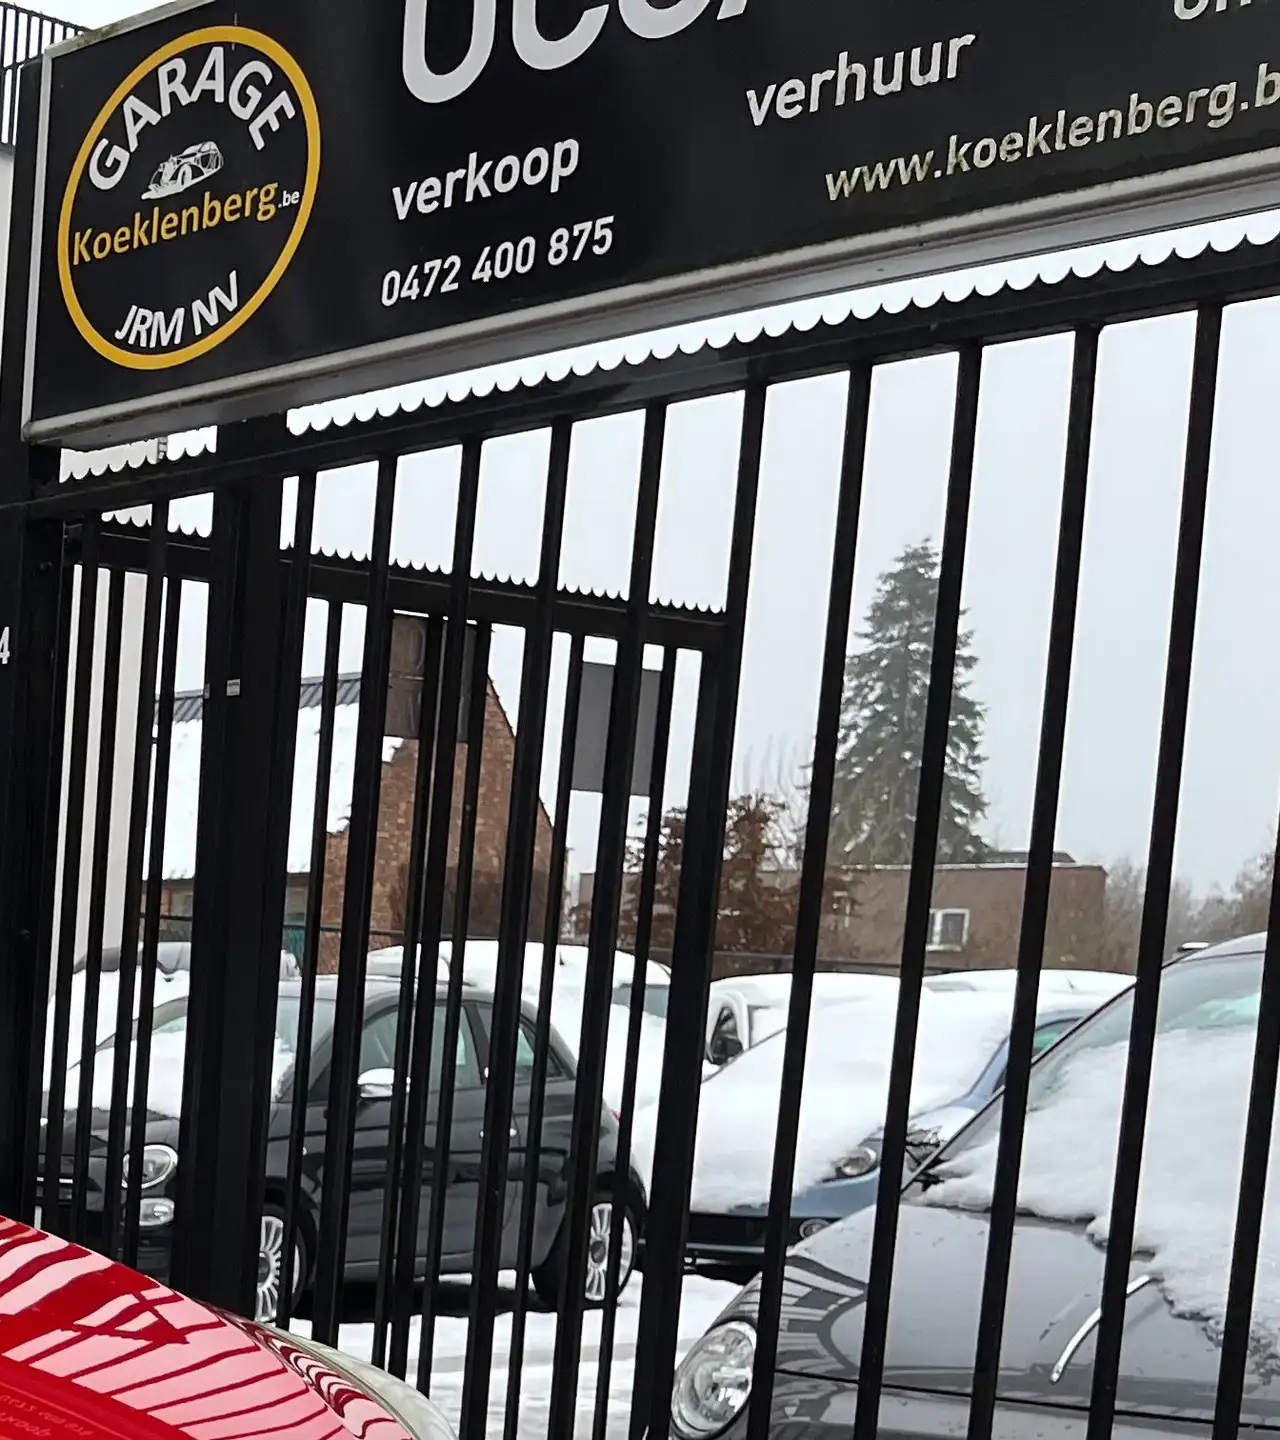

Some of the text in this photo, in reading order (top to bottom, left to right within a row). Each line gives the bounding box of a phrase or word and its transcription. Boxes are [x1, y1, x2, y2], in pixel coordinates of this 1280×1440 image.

[90, 46, 296, 190] GARAGE
[746, 34, 976, 127] verhuur
[825, 63, 1280, 201] www.koeklenberg.b
[392, 138, 580, 221] verkoop
[380, 216, 615, 307] 0472 400 875
[114, 270, 239, 349] JRM NV
